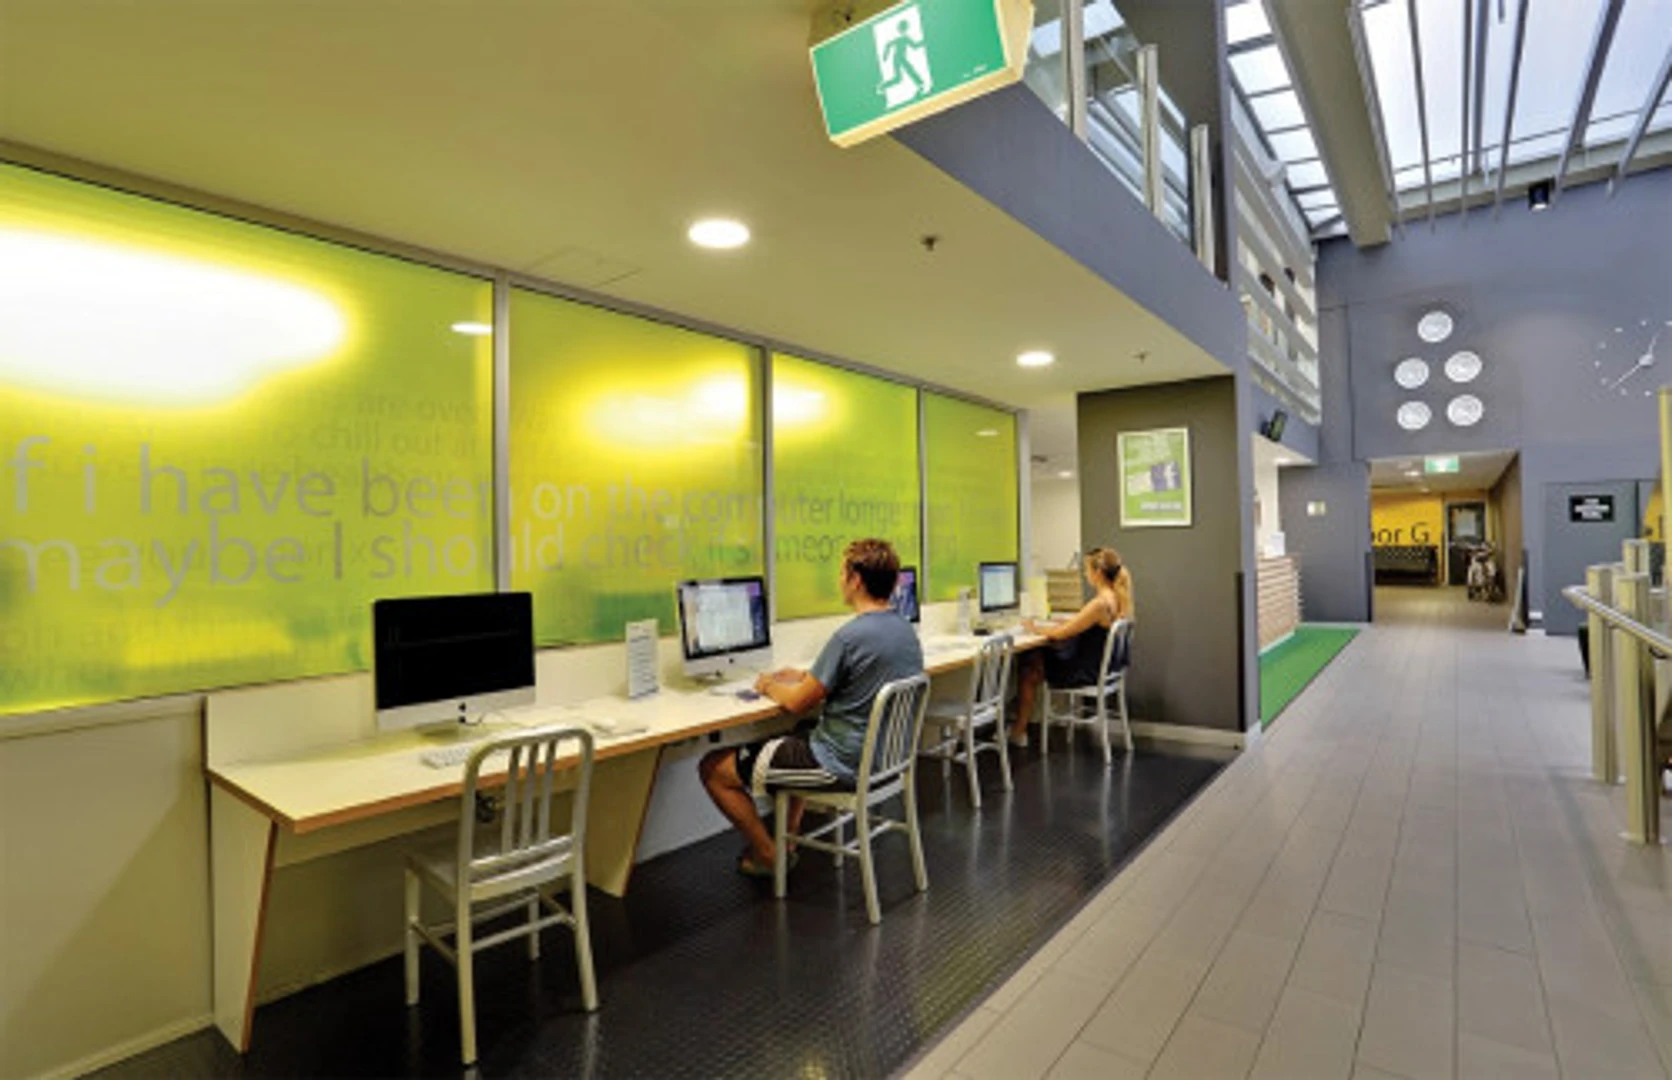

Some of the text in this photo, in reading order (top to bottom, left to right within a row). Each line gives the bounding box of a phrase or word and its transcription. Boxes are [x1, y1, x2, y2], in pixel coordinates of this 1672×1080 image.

[139, 441, 336, 518] have
[362, 455, 514, 519] been
[532, 481, 591, 521] on
[607, 471, 675, 524] the
[682, 486, 834, 534] comuter
[837, 482, 910, 533] longe
[1411, 521, 1430, 544] G
[0, 517, 306, 608] maybe
[370, 519, 564, 581] should
